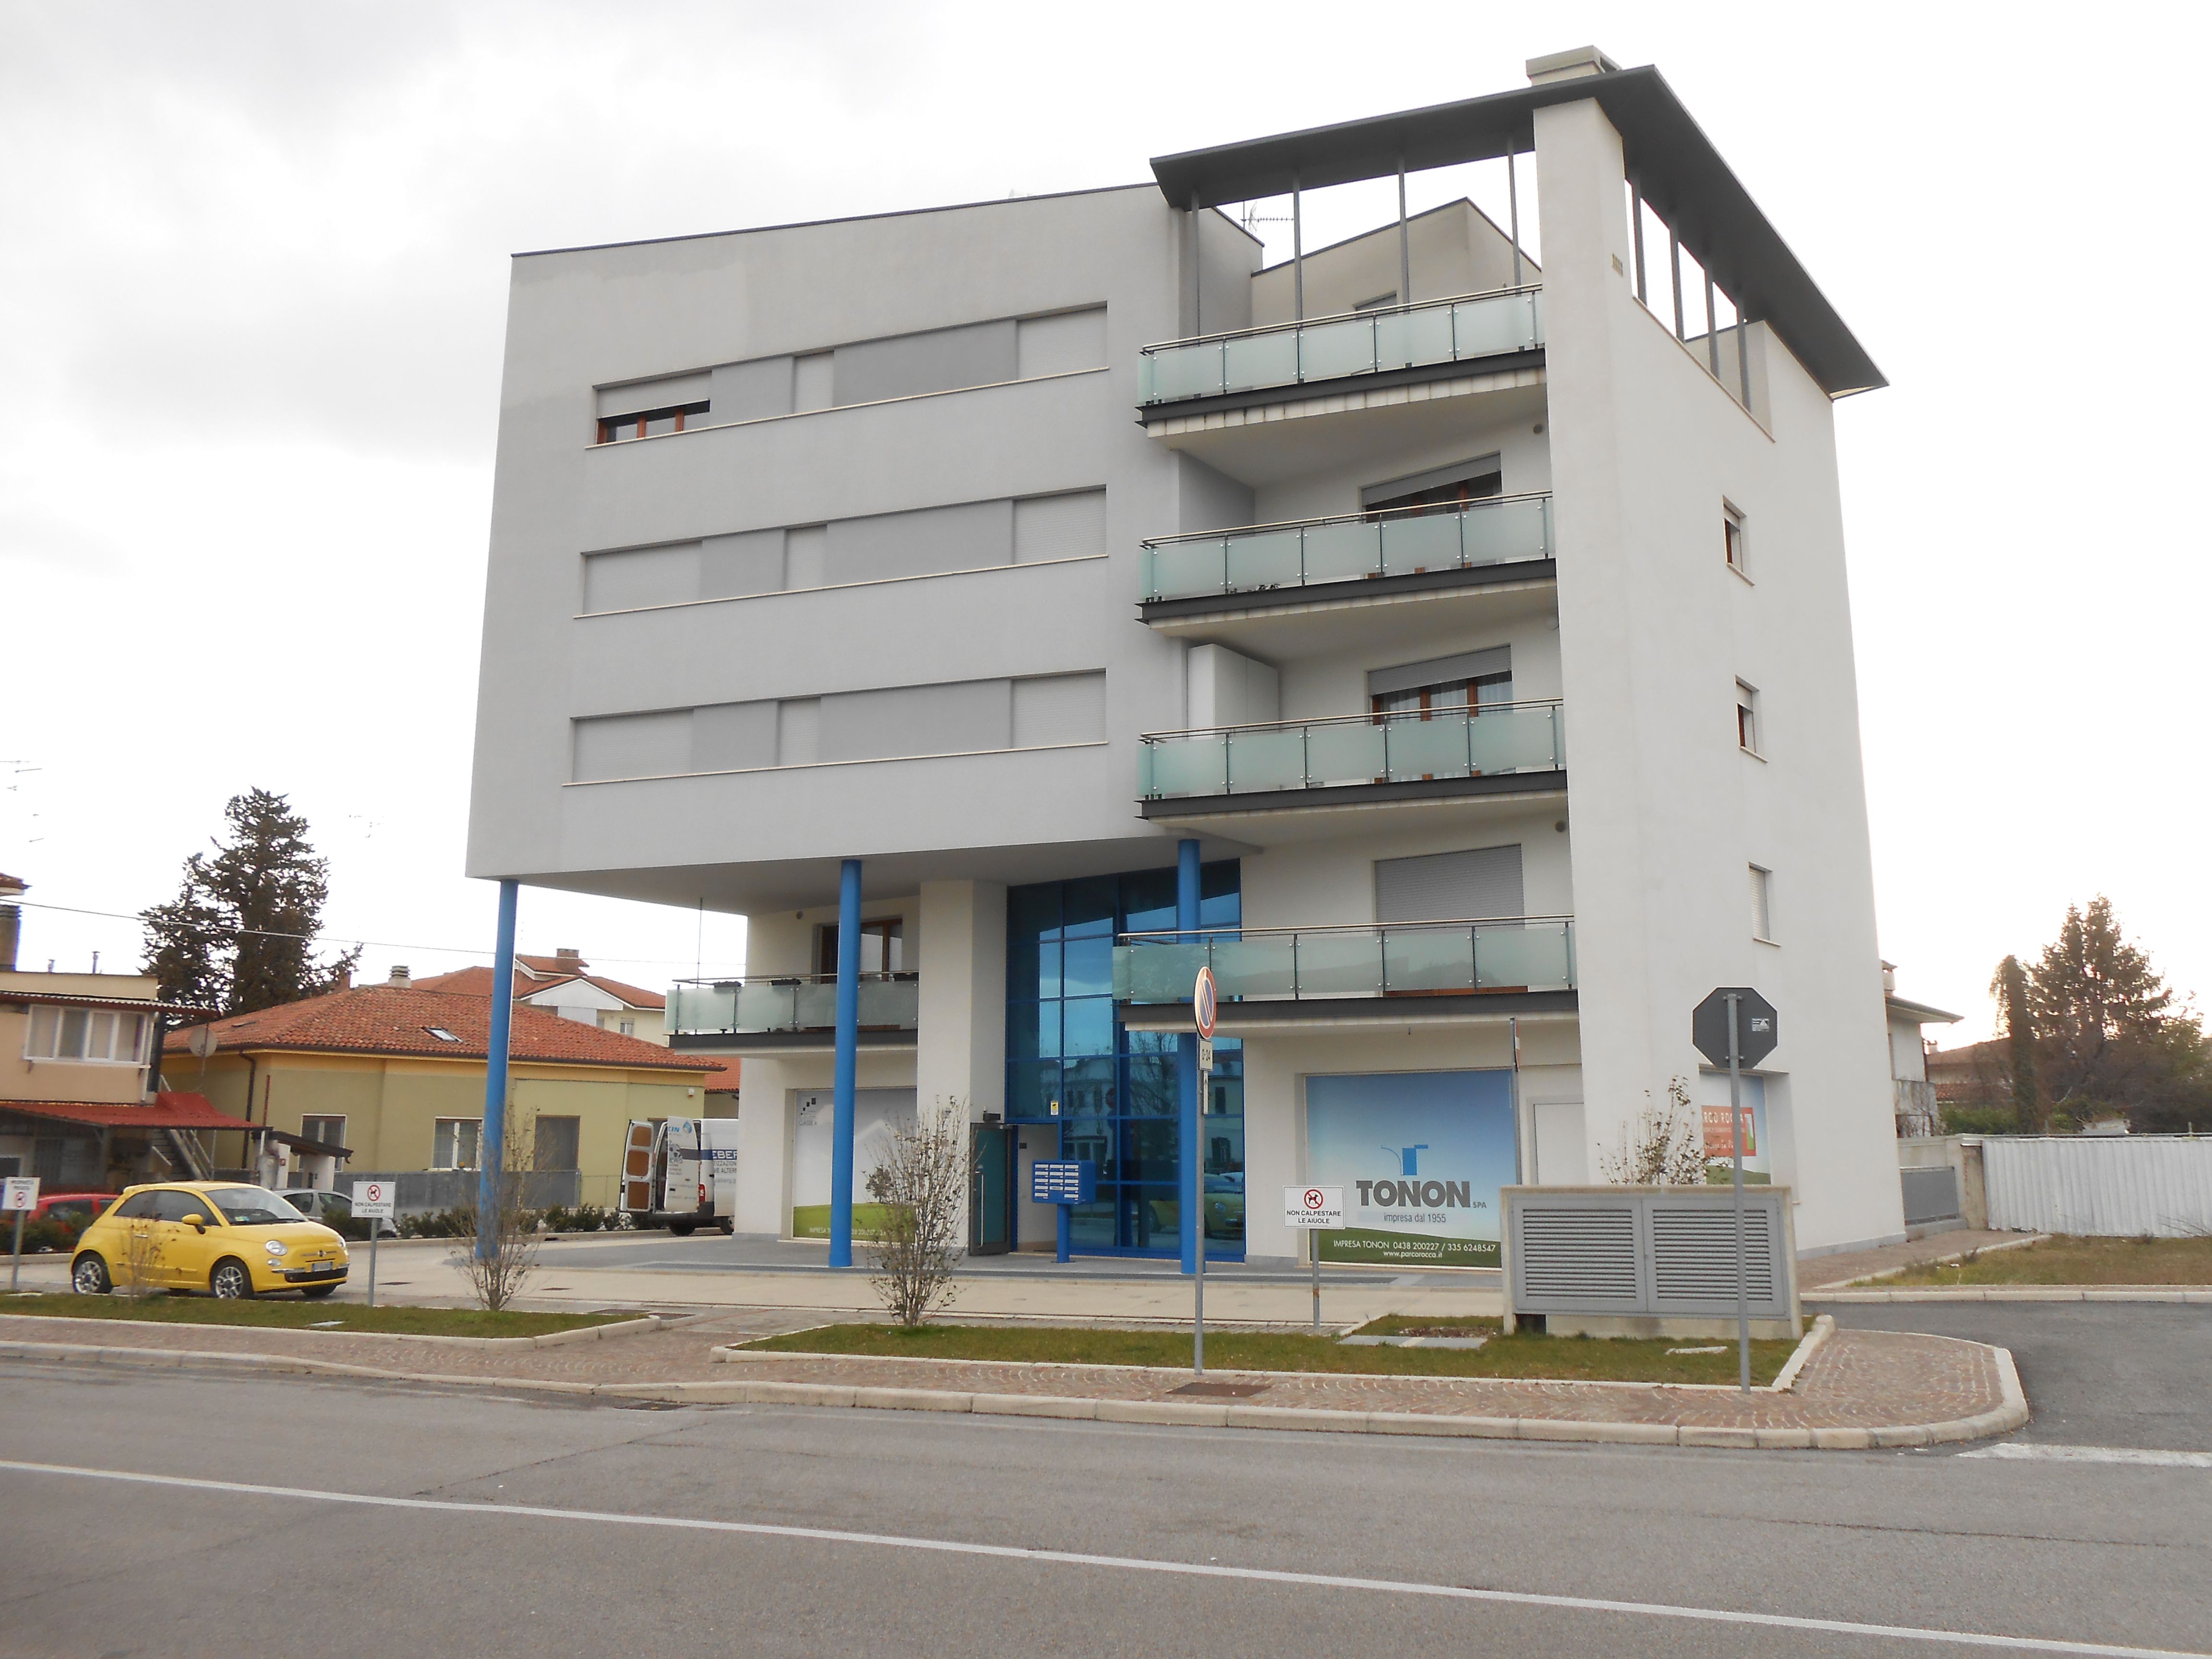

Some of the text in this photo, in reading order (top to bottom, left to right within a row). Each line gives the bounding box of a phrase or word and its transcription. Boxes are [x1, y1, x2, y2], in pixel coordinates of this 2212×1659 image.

[1356, 1180, 1471, 1208] TONON
[1384, 1213, 1446, 1223] impresa dal 1955
[1362, 1240, 1389, 1249] TONON
[1393, 1241, 1411, 1250] 0438
[1413, 1242, 1439, 1250] 200227
[1383, 1250, 1443, 1259] www.parcorocca.it
